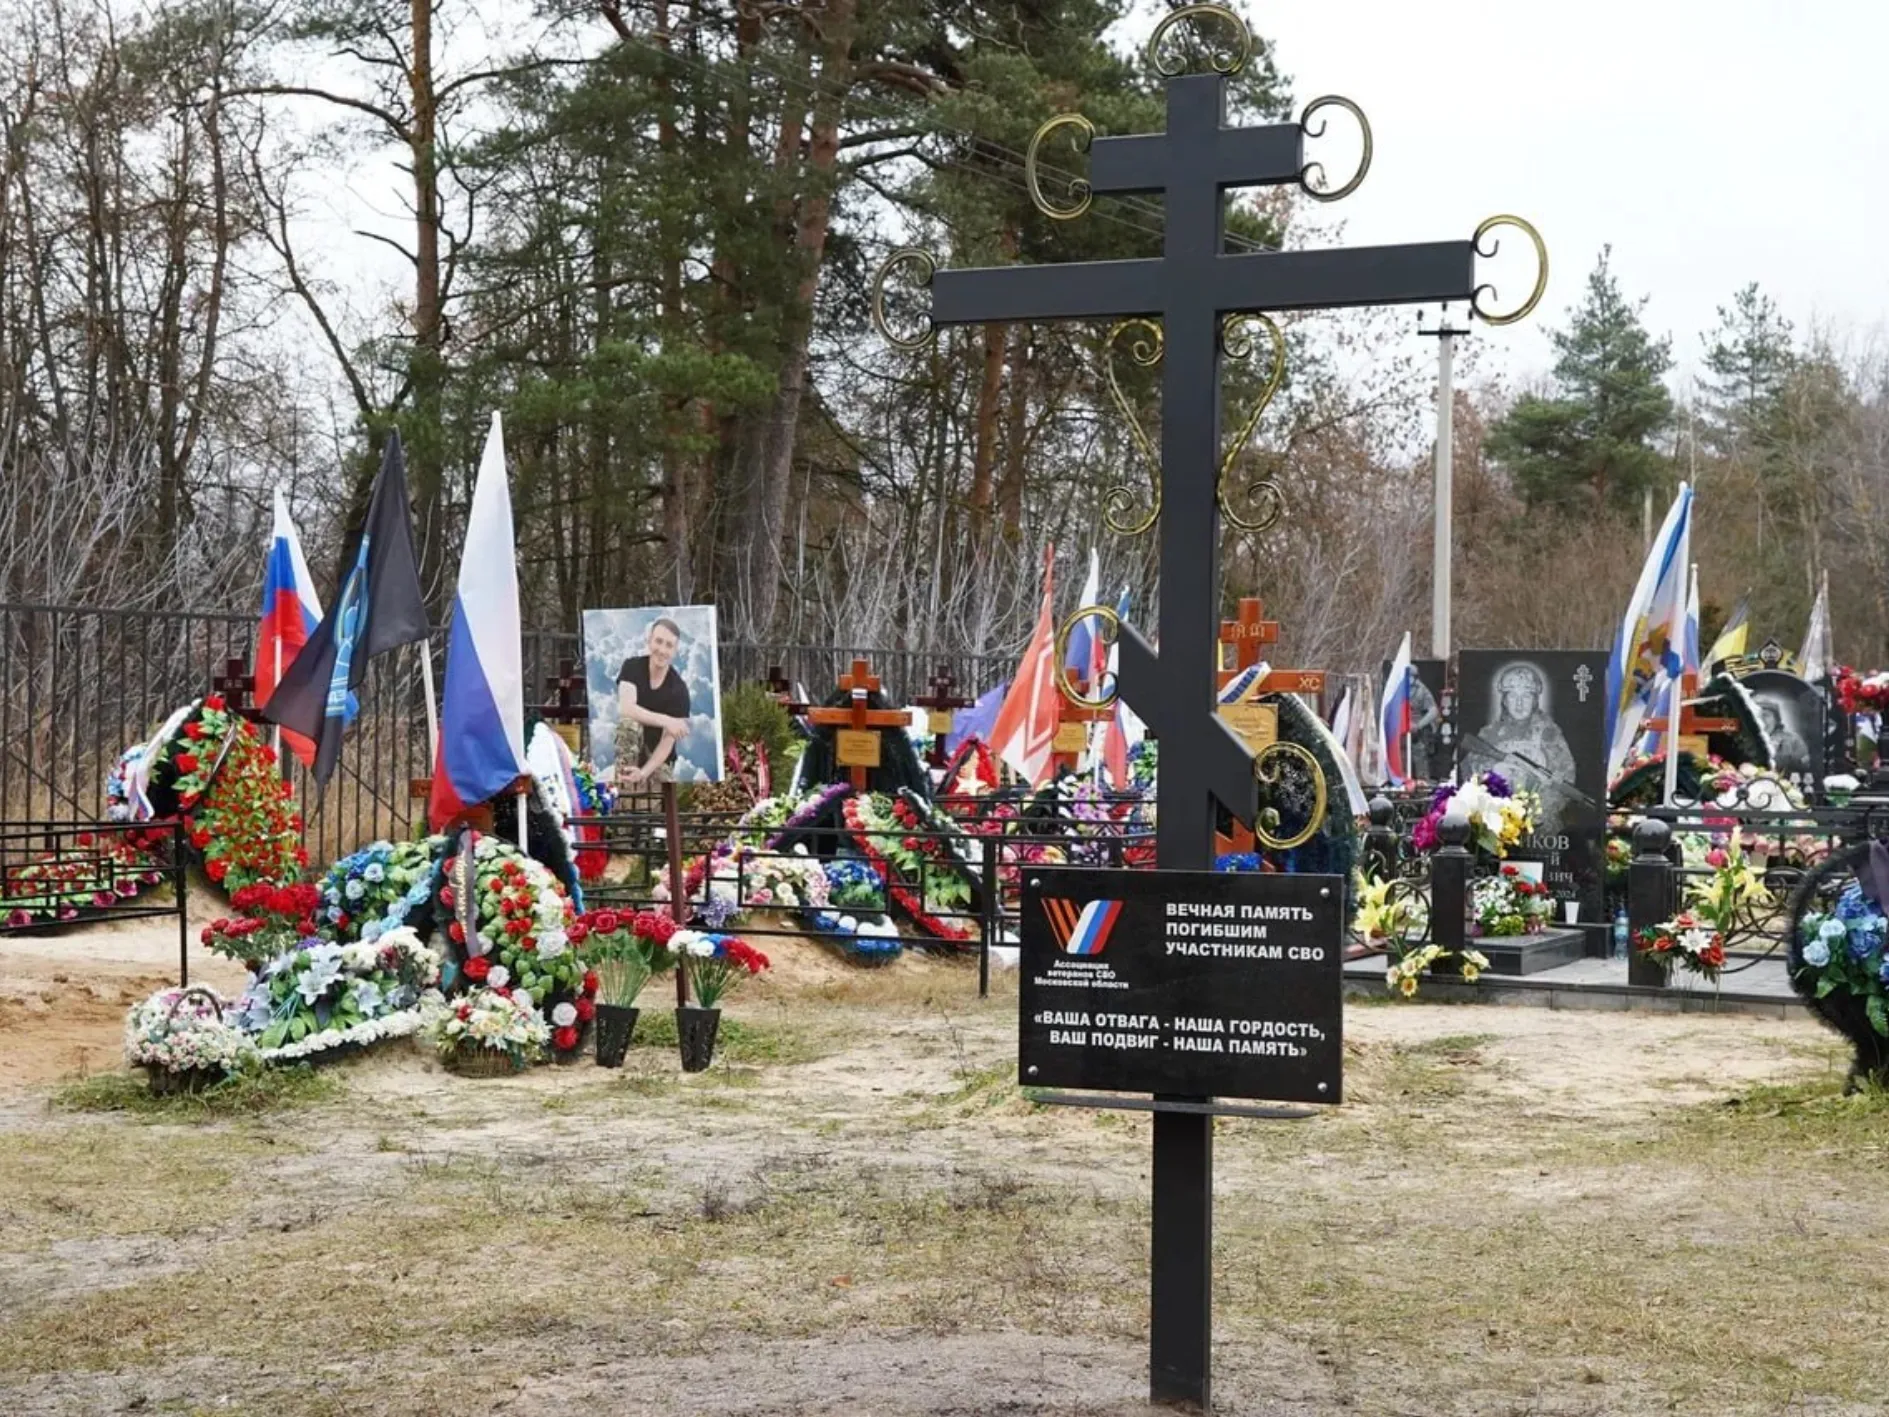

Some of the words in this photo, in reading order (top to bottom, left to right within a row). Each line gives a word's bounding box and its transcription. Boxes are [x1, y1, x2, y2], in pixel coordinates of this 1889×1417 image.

[1166, 903, 1235, 918] ВЕЧНАЯ
[1241, 905, 1313, 920] ПАМЯТЬ
[1166, 922, 1267, 939] ПОГИБШИМ
[1166, 942, 1283, 960] УЧАСТНИКАМ
[1288, 947, 1325, 961] СВО
[1053, 960, 1109, 970] Ассоциация
[1034, 977, 1089, 987] Московской
[1047, 970, 1094, 979] ветеранов
[1096, 970, 1116, 980] СВО
[1034, 1011, 1090, 1026] «ВАША
[1095, 1013, 1159, 1029] ОТВАГА
[1174, 1017, 1225, 1033] НАША
[1229, 1020, 1325, 1041] ГОРДОСТЬ,
[1050, 1030, 1087, 1045] ВАШ
[1092, 1032, 1159, 1050] ПОДВИГ
[1174, 1037, 1223, 1052] НАША
[1229, 1040, 1307, 1057] ПАМЯТЬ»
